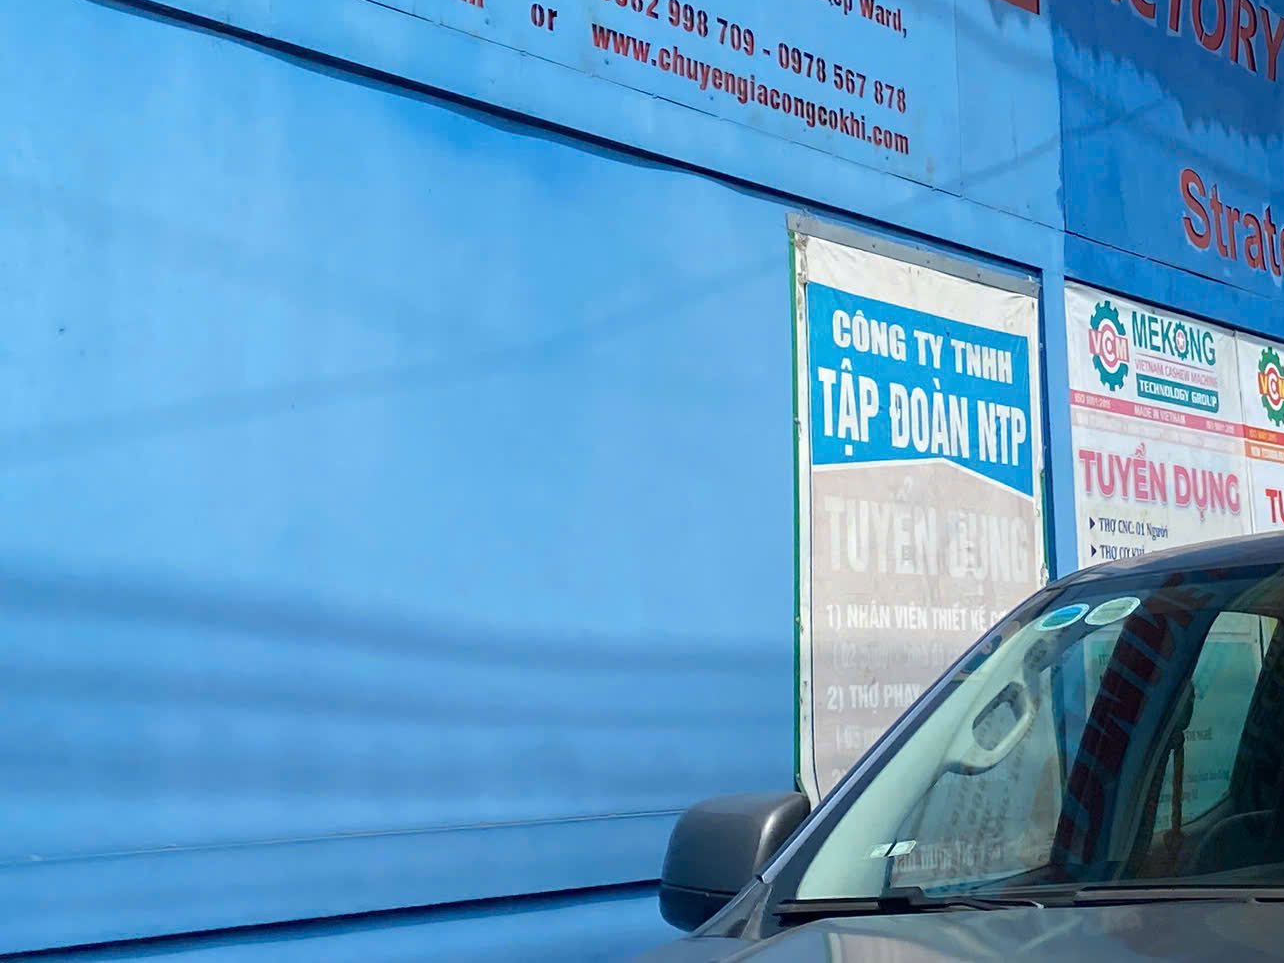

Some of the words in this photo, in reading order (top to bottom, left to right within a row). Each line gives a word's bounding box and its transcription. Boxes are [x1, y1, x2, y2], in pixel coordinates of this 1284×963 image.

[530, 3, 557, 32] or
[591, 22, 909, 155] www.chuyengiacongcokhi.com
[717, 18, 754, 57] 709
[778, 41, 826, 84] 0978
[833, 64, 866, 98] 567
[874, 82, 906, 114] 878
[832, 308, 906, 362] CÔNG
[913, 329, 943, 369] TY
[951, 339, 1013, 385] TNHH
[1131, 310, 1216, 366] MEKONG
[818, 357, 879, 456] TẬP
[889, 377, 970, 460] ĐOÀN
[976, 400, 1027, 467] NTP
[1139, 380, 1189, 403] TECHNOLOGY
[1079, 442, 1167, 503] TUYỂN
[1174, 464, 1240, 522] DỤNG
[1099, 517, 1115, 536] THỢ
[1136, 522, 1145, 535] 01
[826, 604, 841, 630] 1)
[847, 599, 890, 630] NHÂN
[894, 599, 927, 630] VIÊN
[827, 685, 843, 712] 2)
